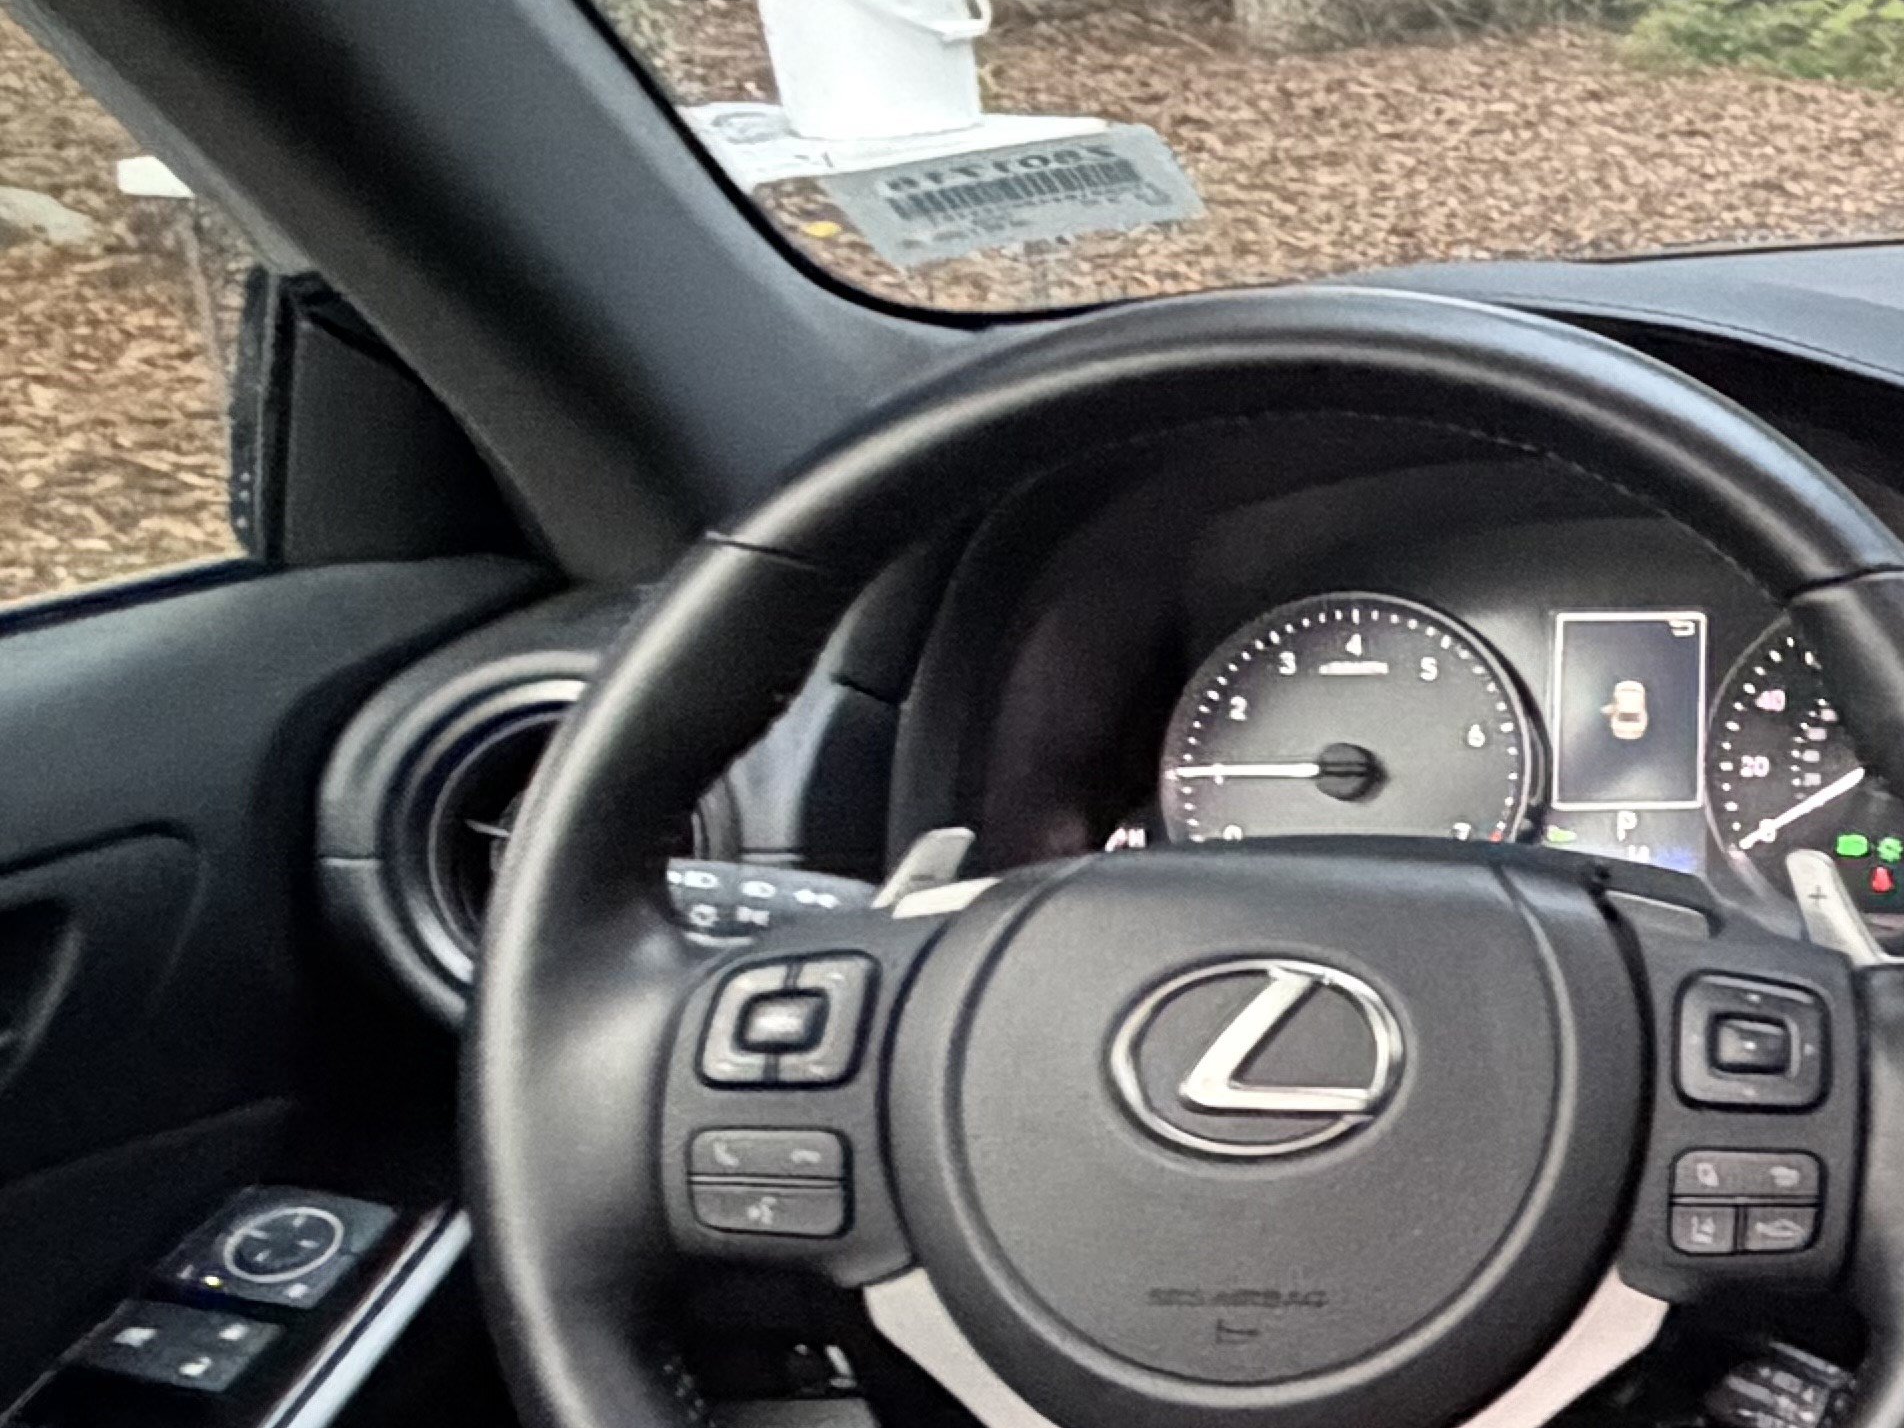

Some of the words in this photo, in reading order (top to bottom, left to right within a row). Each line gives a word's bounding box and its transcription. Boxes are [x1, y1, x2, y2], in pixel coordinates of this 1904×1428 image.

[1345, 633, 1363, 657] 4
[1278, 651, 1297, 677] 3
[1419, 656, 1439, 682] 5
[1228, 696, 1249, 722] 2
[1467, 722, 1487, 749] 6
[1740, 754, 1770, 778] 20
[1616, 810, 1638, 843] P
